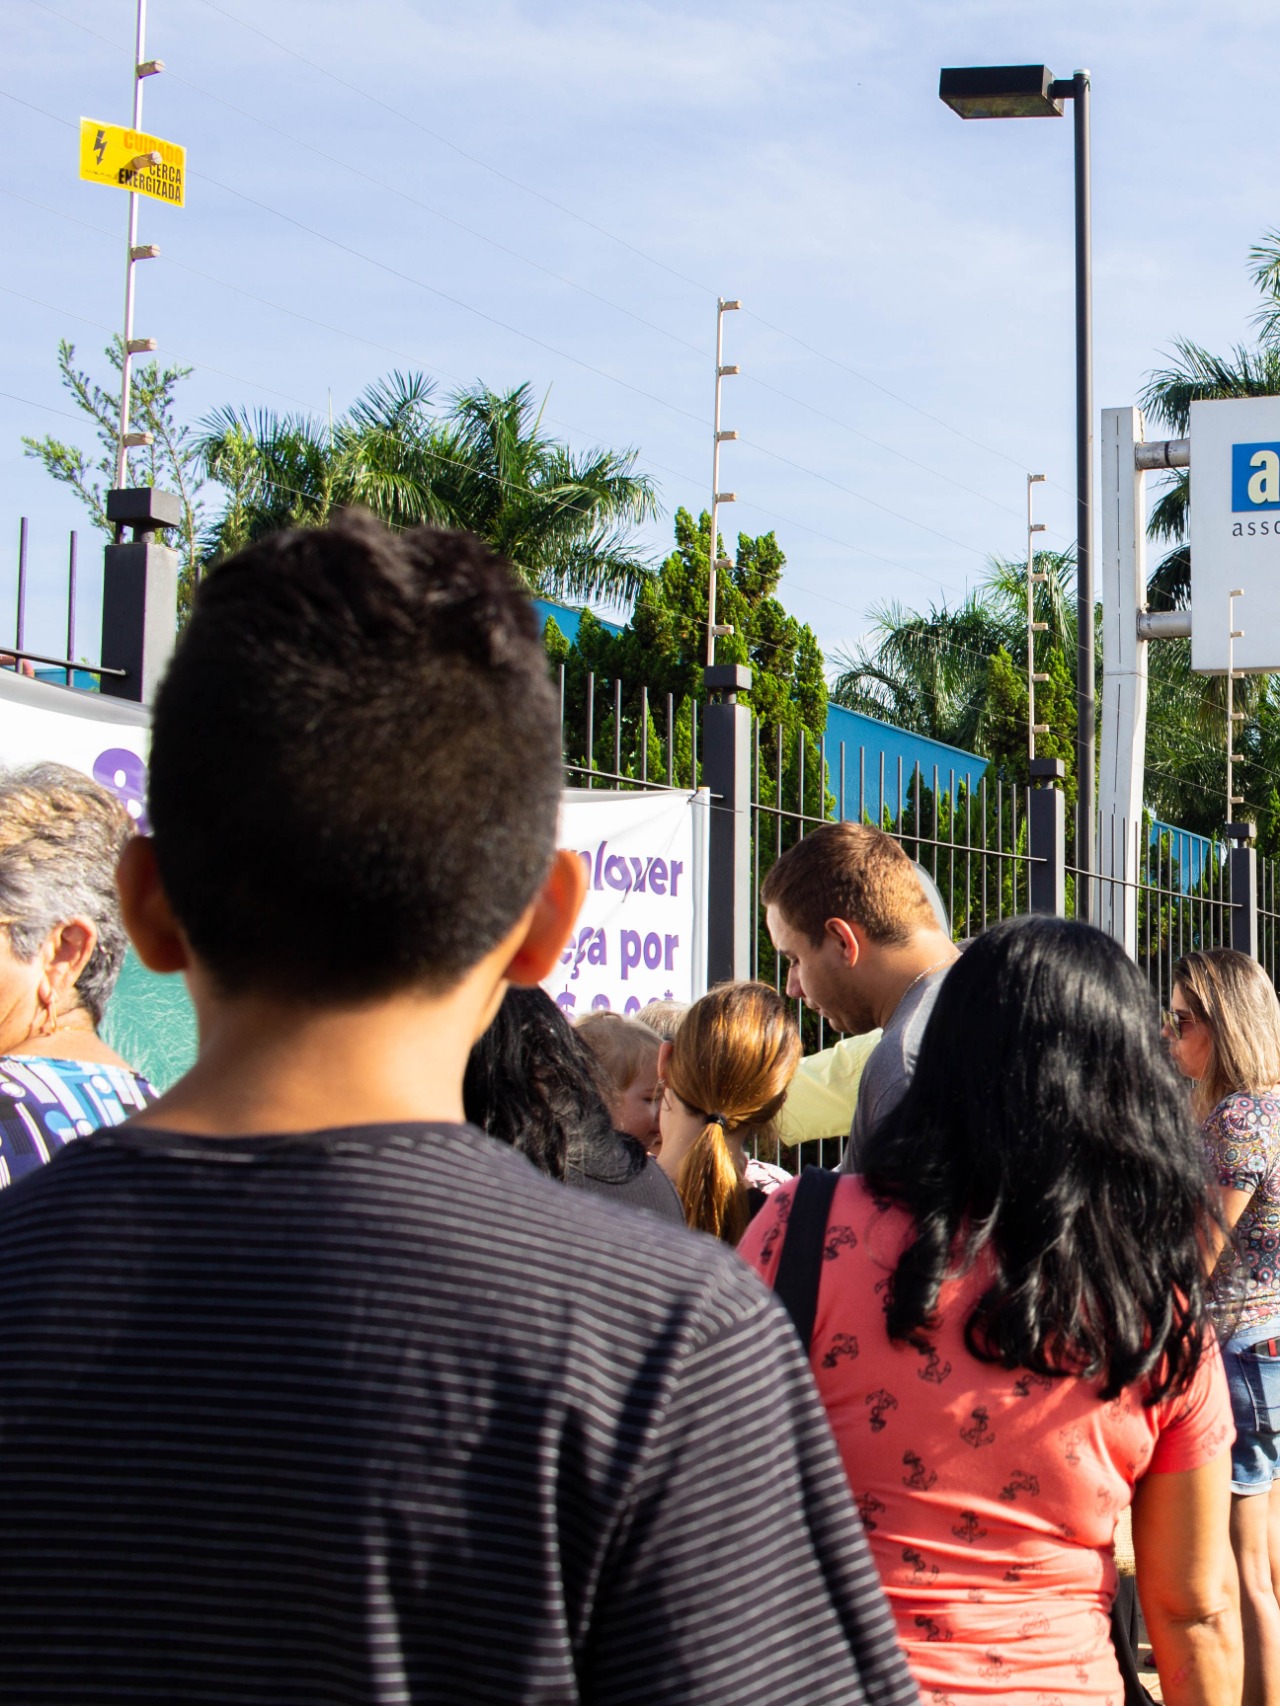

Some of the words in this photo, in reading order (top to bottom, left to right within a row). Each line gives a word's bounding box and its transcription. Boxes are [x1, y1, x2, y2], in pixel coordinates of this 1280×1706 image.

[123, 131, 183, 166] CUIDADO
[118, 168, 181, 203] ENERGIZADA
[149, 162, 182, 185] CERCA
[559, 926, 607, 980] eça
[620, 928, 680, 980] por
